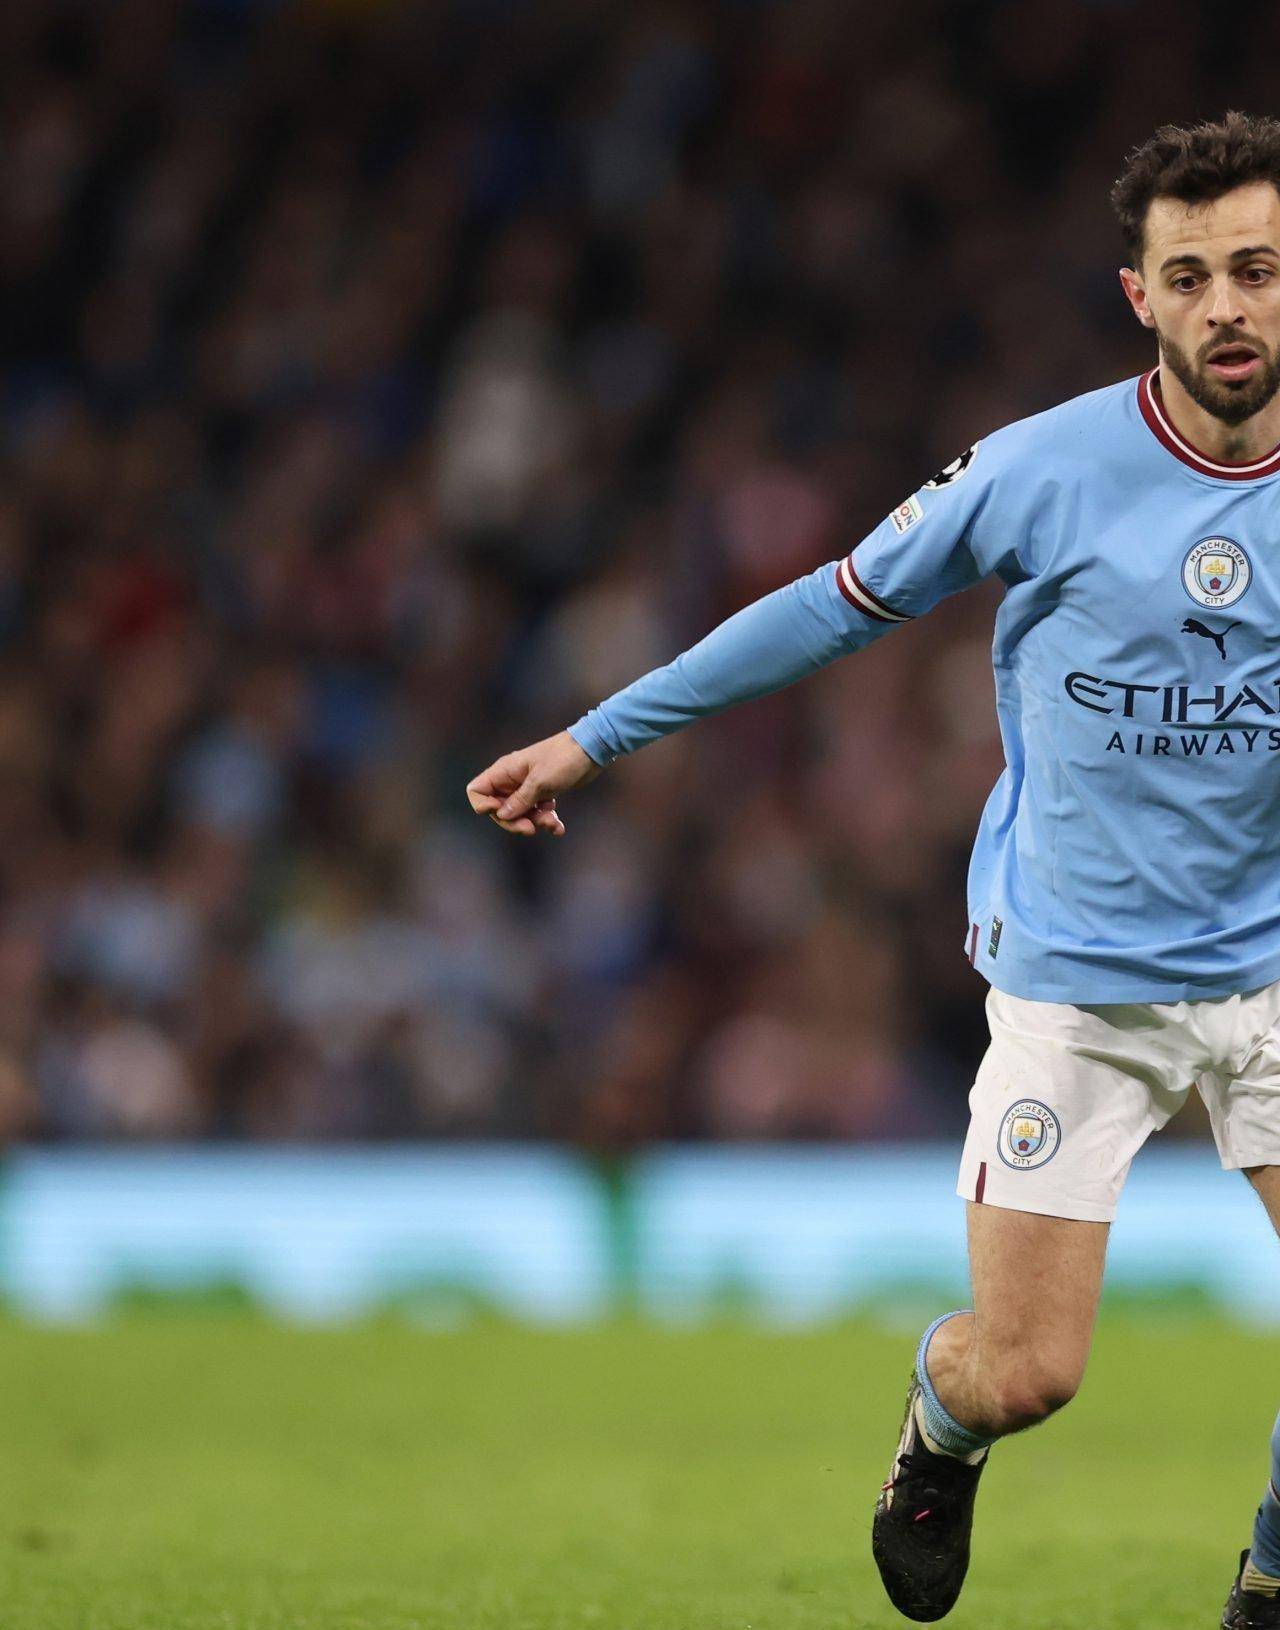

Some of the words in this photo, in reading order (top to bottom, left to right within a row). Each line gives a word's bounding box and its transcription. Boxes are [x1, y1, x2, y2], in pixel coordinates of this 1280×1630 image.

[1190, 541, 1245, 566] MANCHESTER
[1006, 1104, 1054, 1129] MANCHESTER
[1012, 1157, 1031, 1165] CITY
